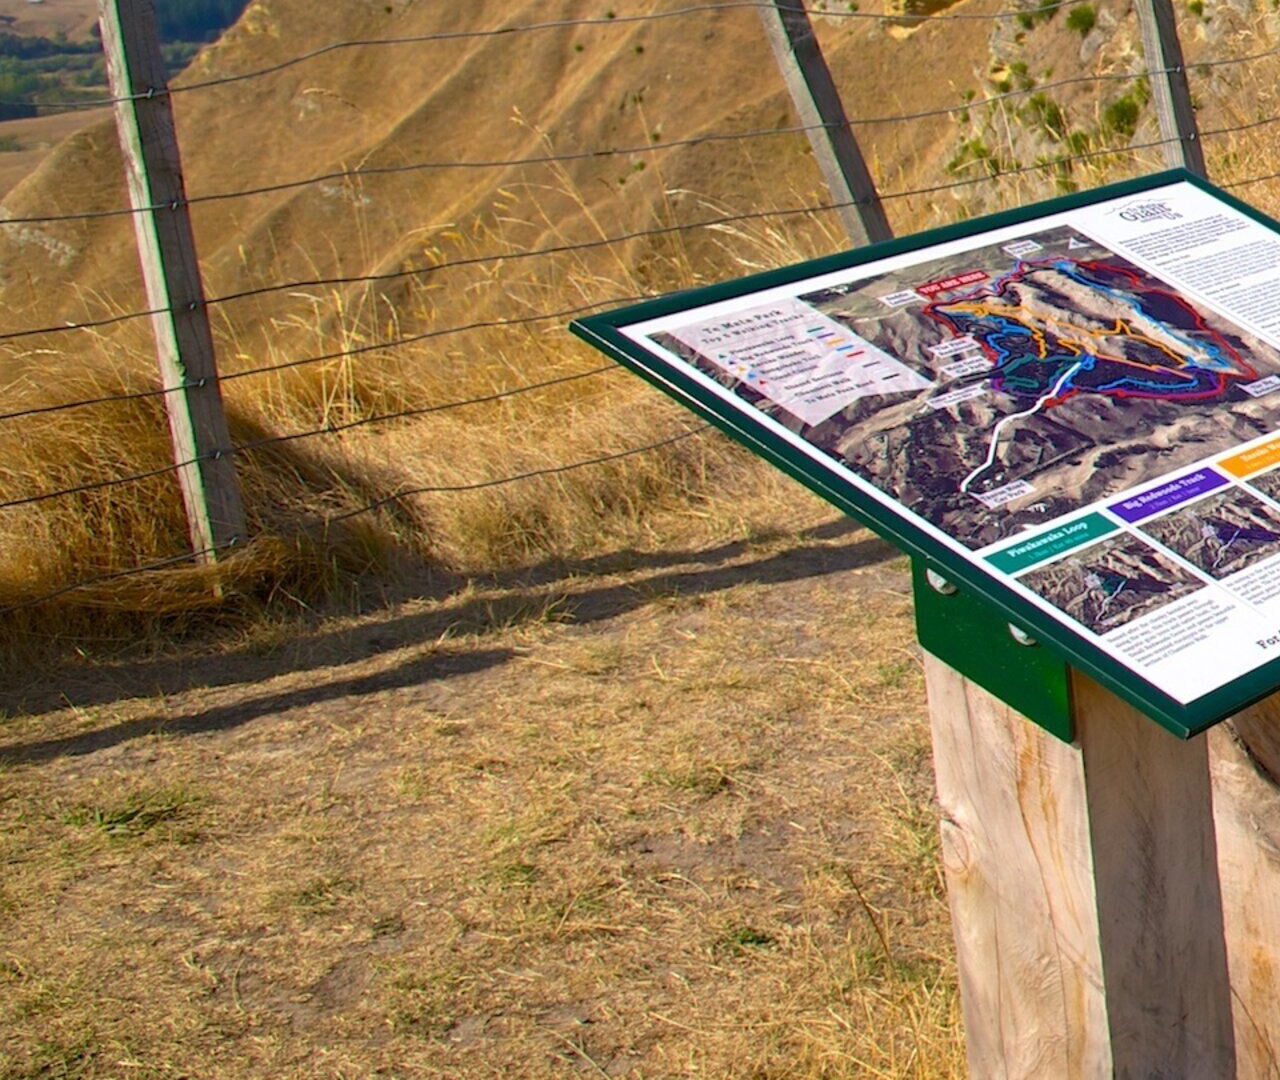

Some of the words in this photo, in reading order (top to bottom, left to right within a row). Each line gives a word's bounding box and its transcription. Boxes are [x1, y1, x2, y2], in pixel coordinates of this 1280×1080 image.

[1119, 202, 1172, 222] Giant
[918, 284, 942, 293] YOU
[938, 279, 960, 287] ARE
[958, 272, 986, 282] HERE
[701, 336, 721, 344] Top
[732, 323, 771, 335] Walking
[773, 314, 804, 324] Tracks
[722, 318, 752, 328] Mata
[754, 310, 782, 319] Park
[1008, 489, 1025, 497] Park
[1122, 500, 1143, 510] Big
[1138, 484, 1181, 502] Redwoods
[1179, 474, 1206, 485] Track
[1006, 532, 1064, 556] Piwakawaka
[1062, 522, 1090, 534] Loop
[1256, 635, 1280, 648] For
